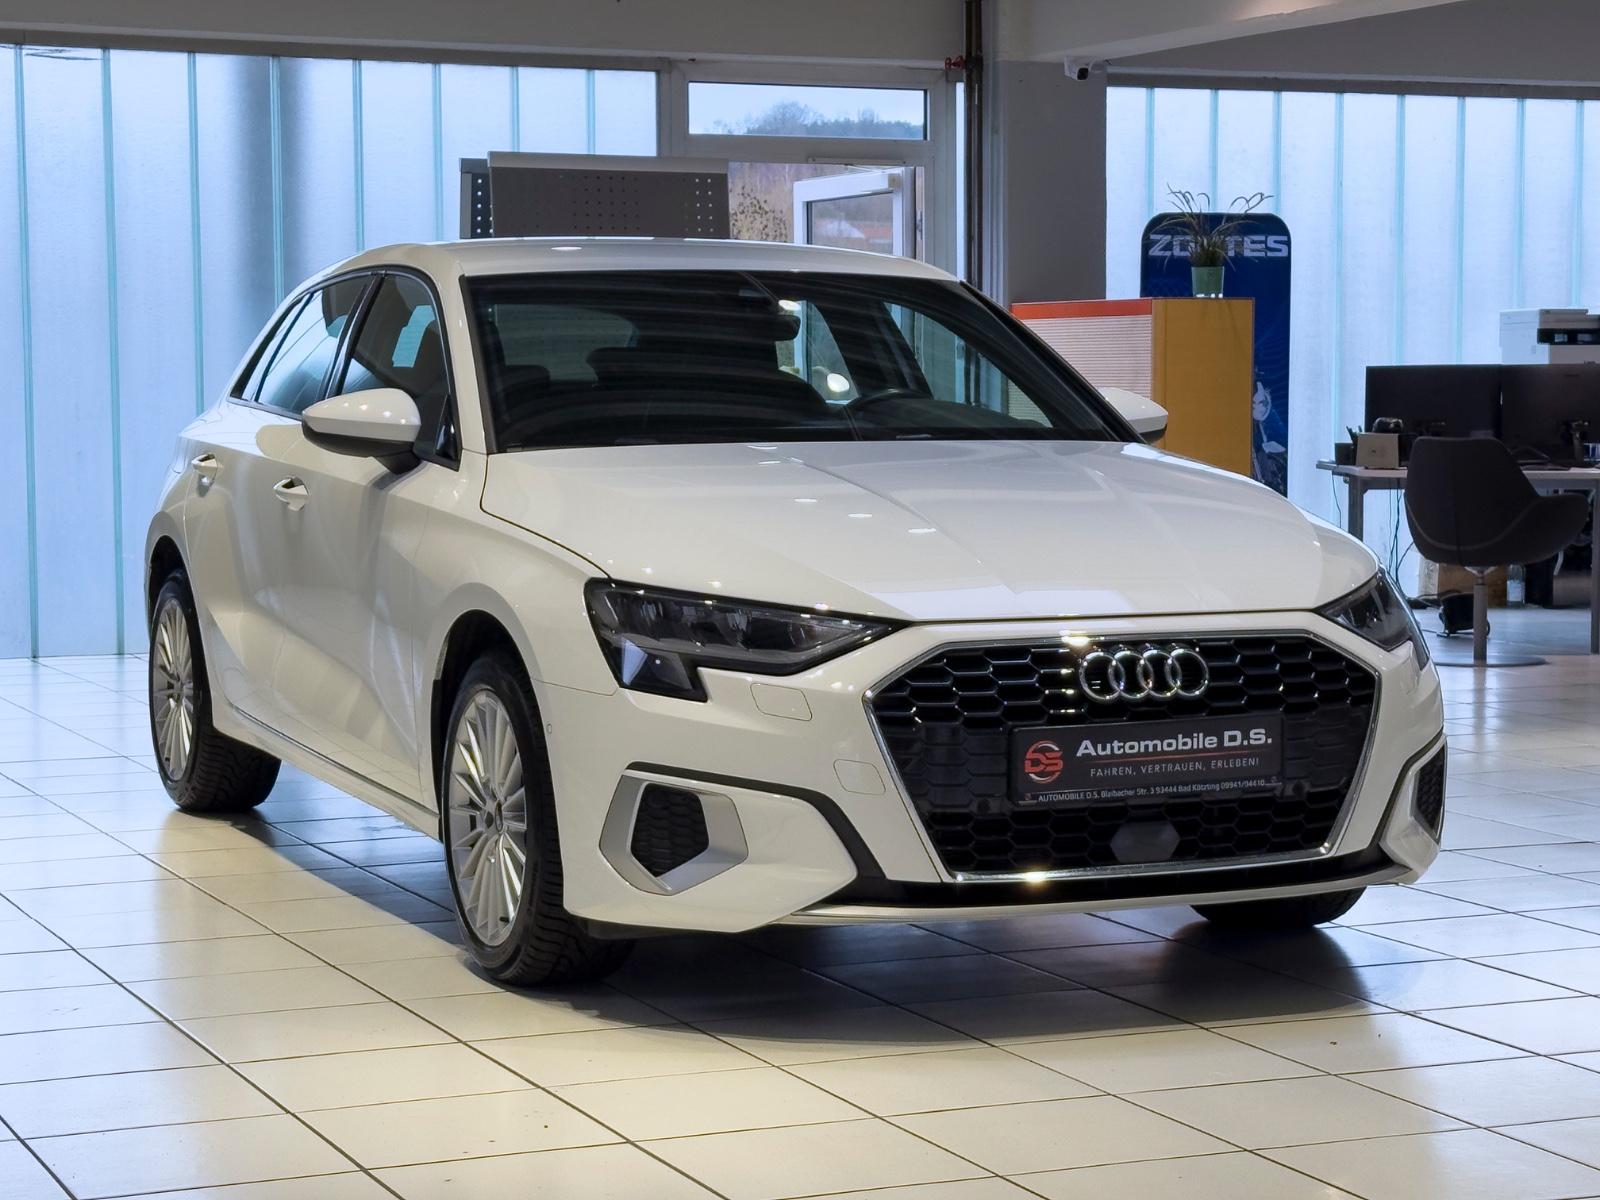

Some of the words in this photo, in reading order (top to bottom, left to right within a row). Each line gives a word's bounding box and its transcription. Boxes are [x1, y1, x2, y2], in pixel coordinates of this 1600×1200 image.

[1148, 234, 1289, 257] ZOTES
[1076, 732, 1218, 757] Automobile
[1223, 728, 1273, 747] D.S.
[1090, 767, 1136, 777] FAHREN,
[1141, 761, 1206, 774] VERTRAUEN,
[1211, 758, 1260, 769] ERLEBEN!
[1038, 792, 1084, 802] AUTOMOBILE
[1179, 783, 1192, 793] Bad
